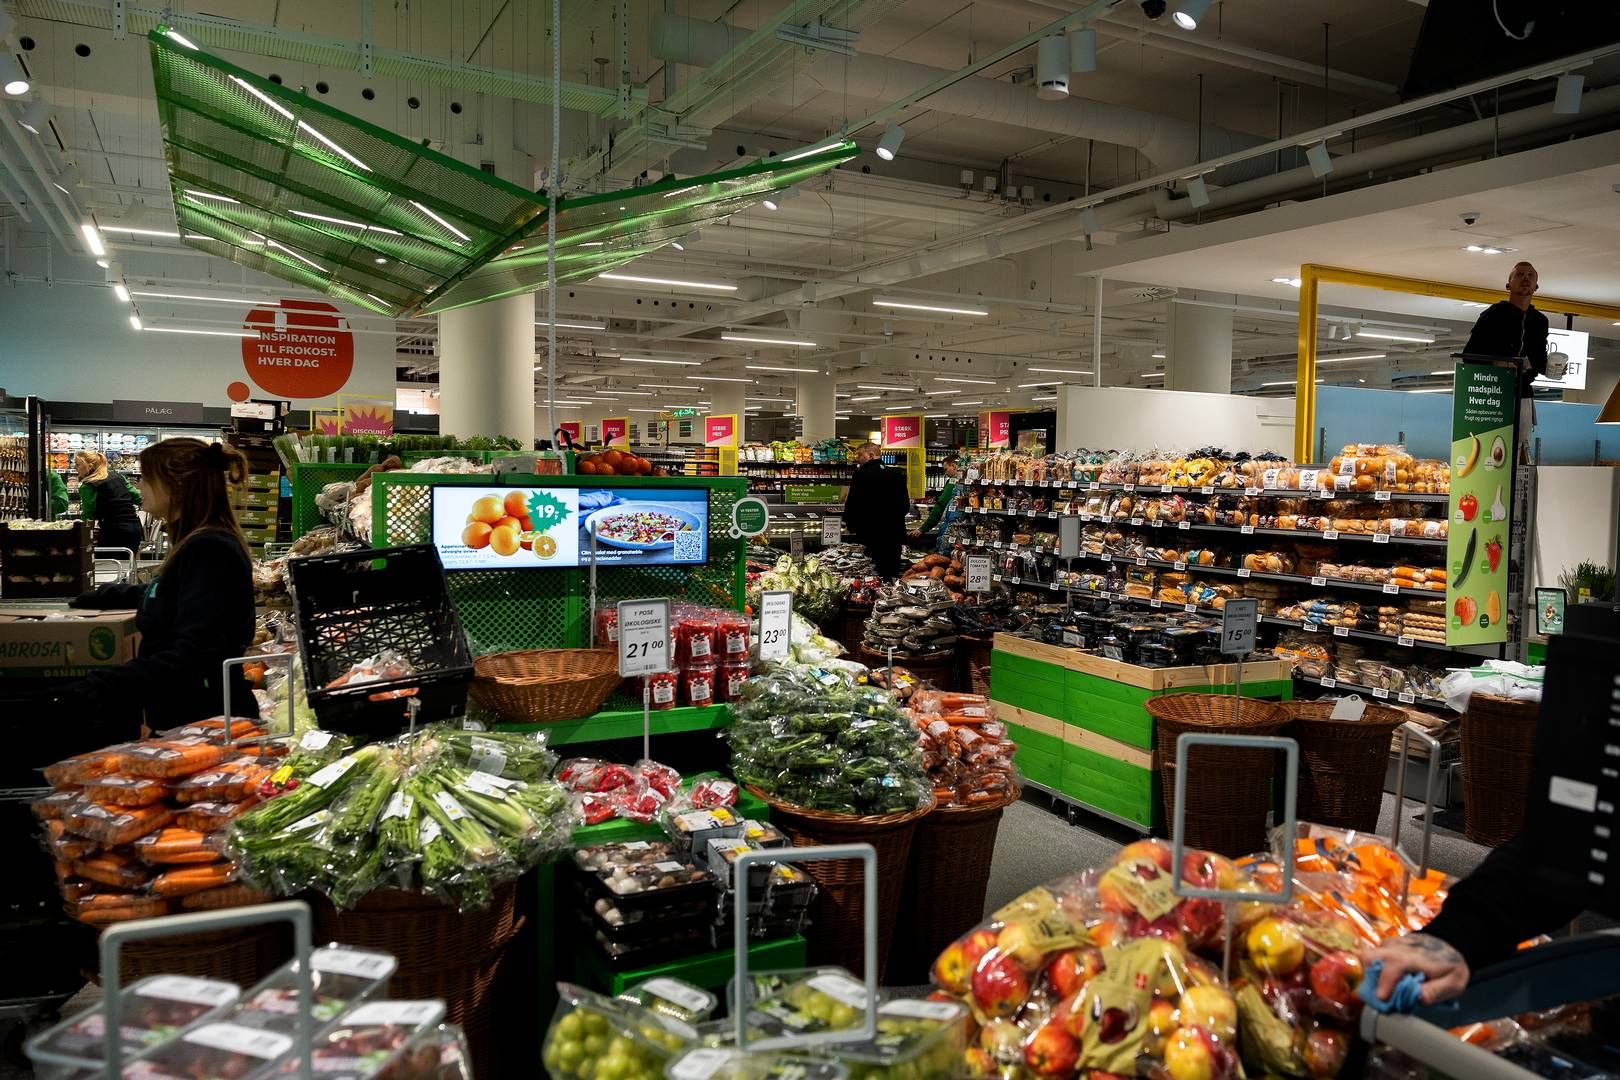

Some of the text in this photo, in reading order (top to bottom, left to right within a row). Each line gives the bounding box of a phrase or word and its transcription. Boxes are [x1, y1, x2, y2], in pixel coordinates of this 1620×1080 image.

[258, 333, 336, 345] INSPIRATION
[257, 344, 337, 357] TIL FROKOST.
[257, 357, 319, 368] HVER DAG
[1473, 373, 1499, 382] Mindre
[1468, 385, 1503, 395] madspild.
[1469, 396, 1501, 407] Hver dag
[145, 407, 173, 415] PÅLÆG
[970, 575, 981, 584] 28
[763, 629, 779, 644] 23
[1228, 629, 1243, 641] 15
[626, 642, 649, 659] 21
